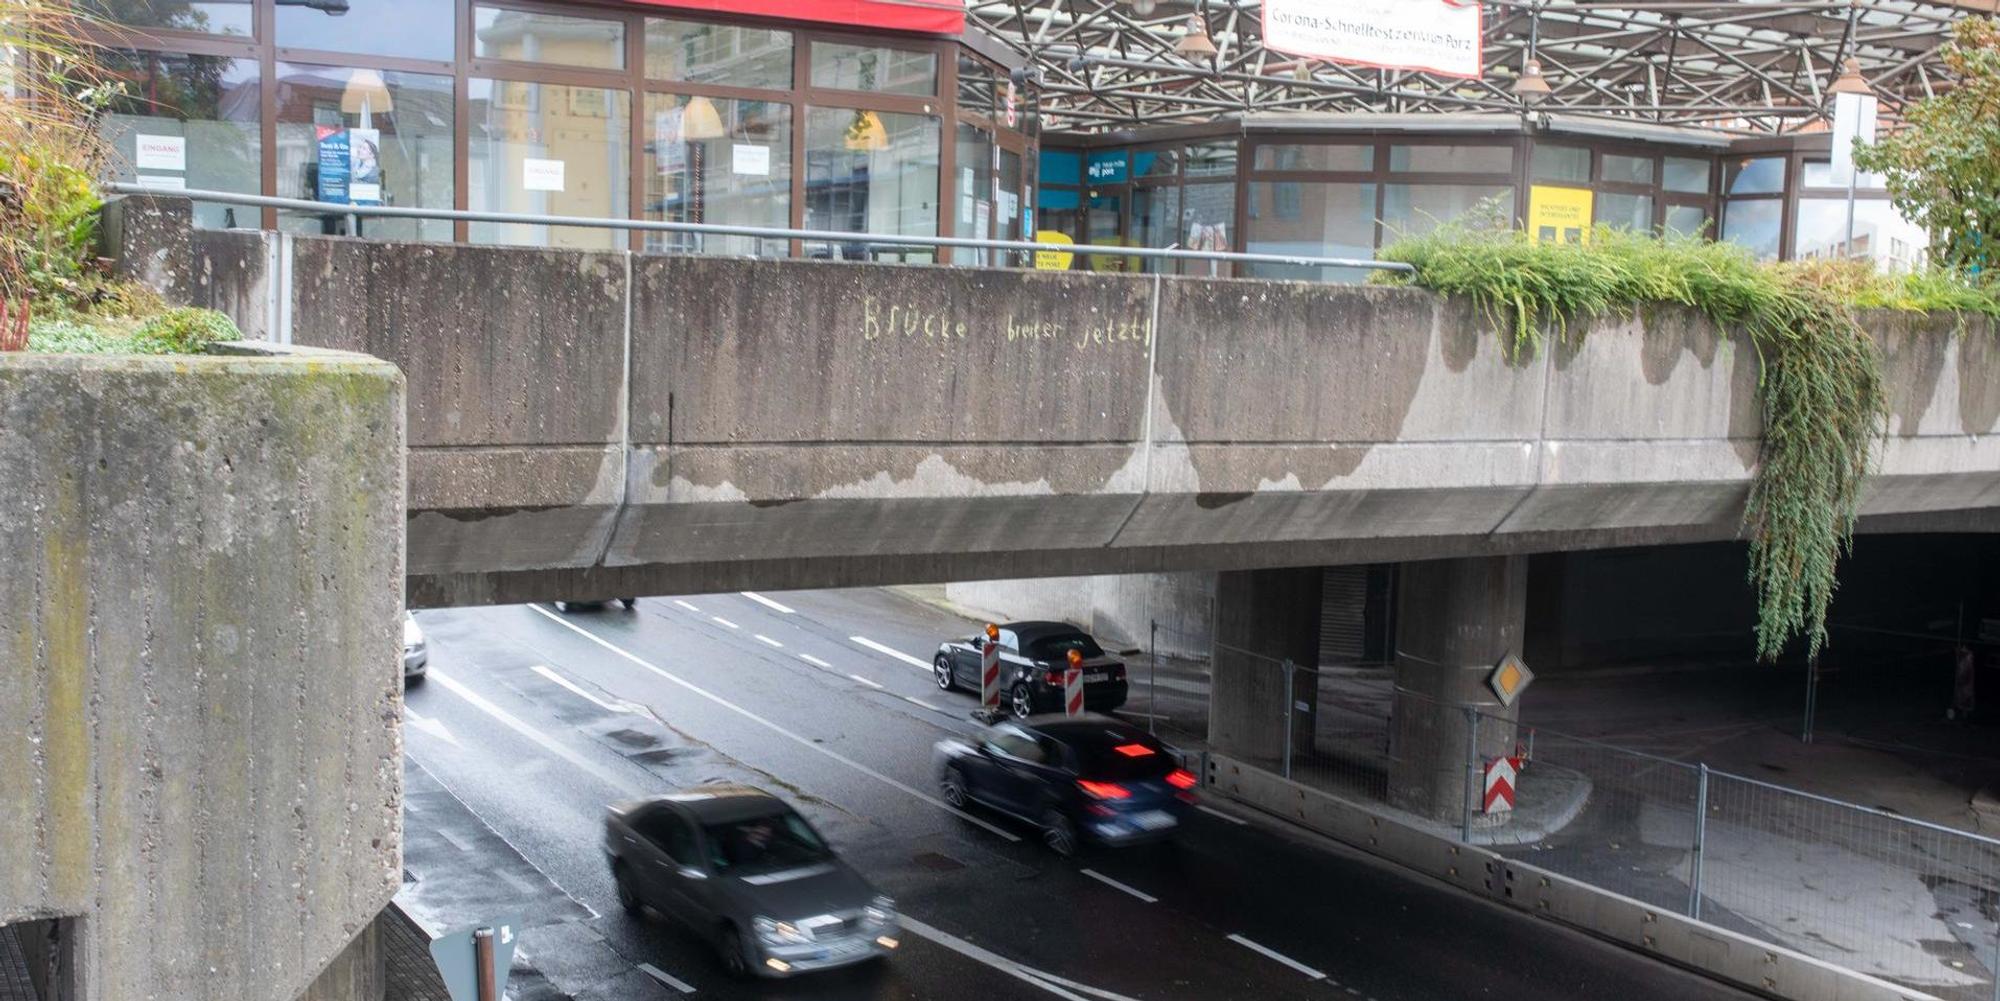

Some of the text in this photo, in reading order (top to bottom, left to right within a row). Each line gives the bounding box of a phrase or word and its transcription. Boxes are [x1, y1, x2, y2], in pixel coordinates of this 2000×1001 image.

[1272, 7, 1444, 46] Corona-Schnelltestzentrum
[1445, 33, 1472, 51] Porz
[142, 143, 180, 153] EINGANG
[1007, 314, 1064, 342] breiter
[1075, 315, 1151, 357] jetzt!
